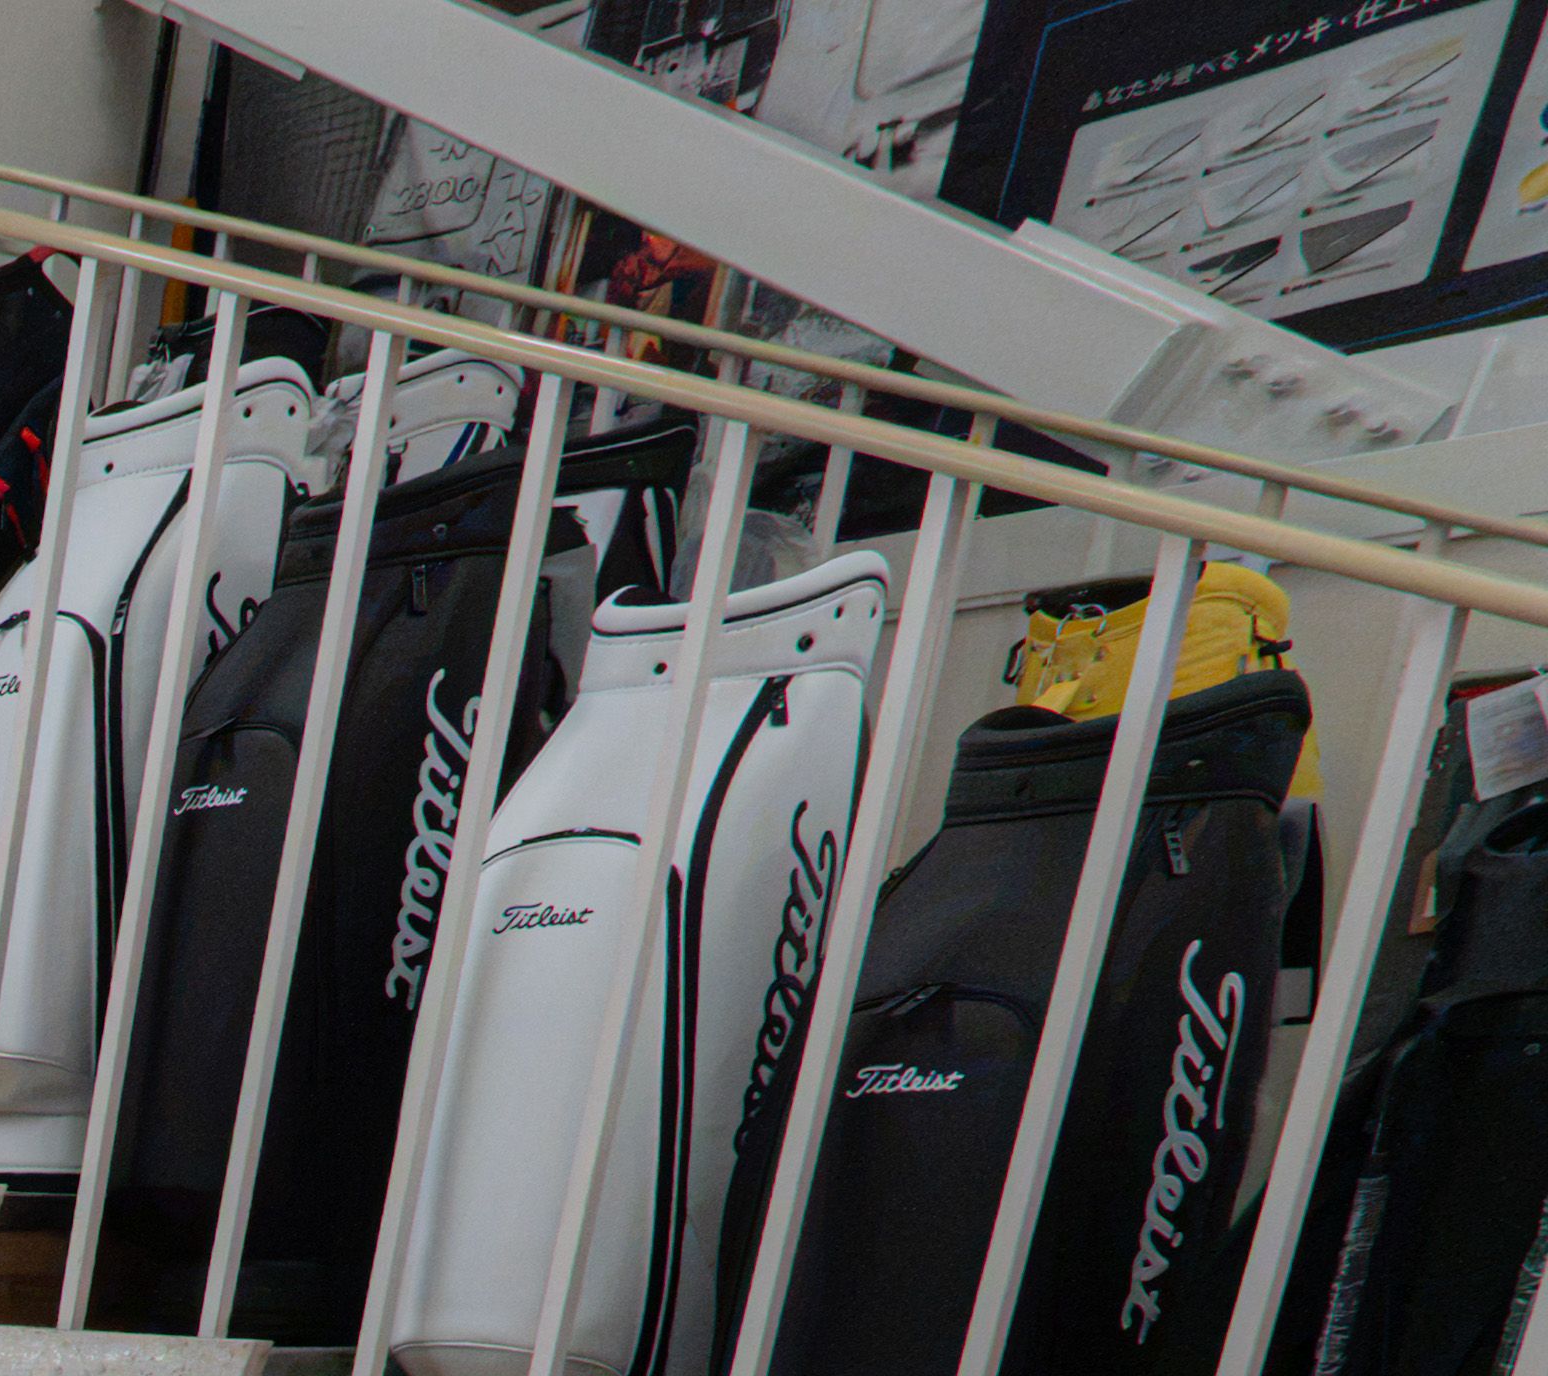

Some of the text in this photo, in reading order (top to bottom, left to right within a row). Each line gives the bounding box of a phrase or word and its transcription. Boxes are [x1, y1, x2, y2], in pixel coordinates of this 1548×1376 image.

[175, 783, 245, 816] Titleist
[493, 902, 593, 934] Titleist
[846, 1064, 963, 1099] Titleist
[1121, 939, 1245, 1344] Titleist
